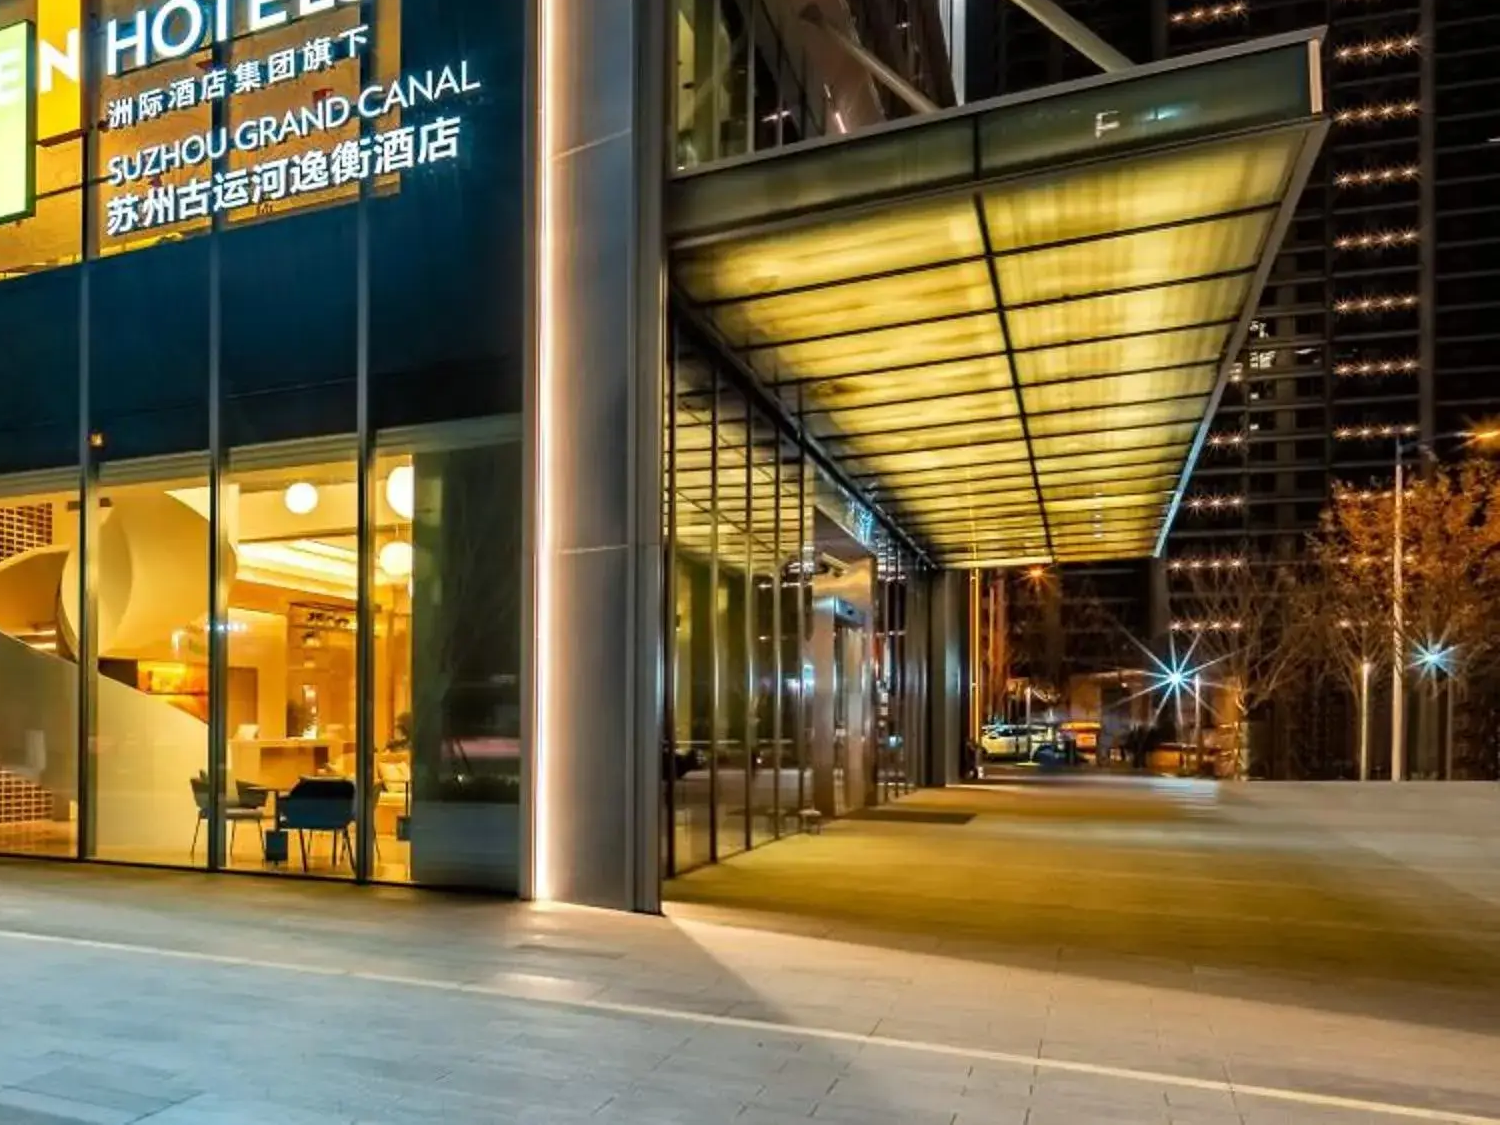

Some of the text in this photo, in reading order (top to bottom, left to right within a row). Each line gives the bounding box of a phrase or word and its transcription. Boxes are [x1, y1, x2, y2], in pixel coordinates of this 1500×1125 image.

[107, 24, 369, 129] 洲际酒店集团旗下
[107, 60, 482, 186] SUZHOU GRAND CANAL
[106, 115, 462, 236] 苏州古运河逸衡酒店
